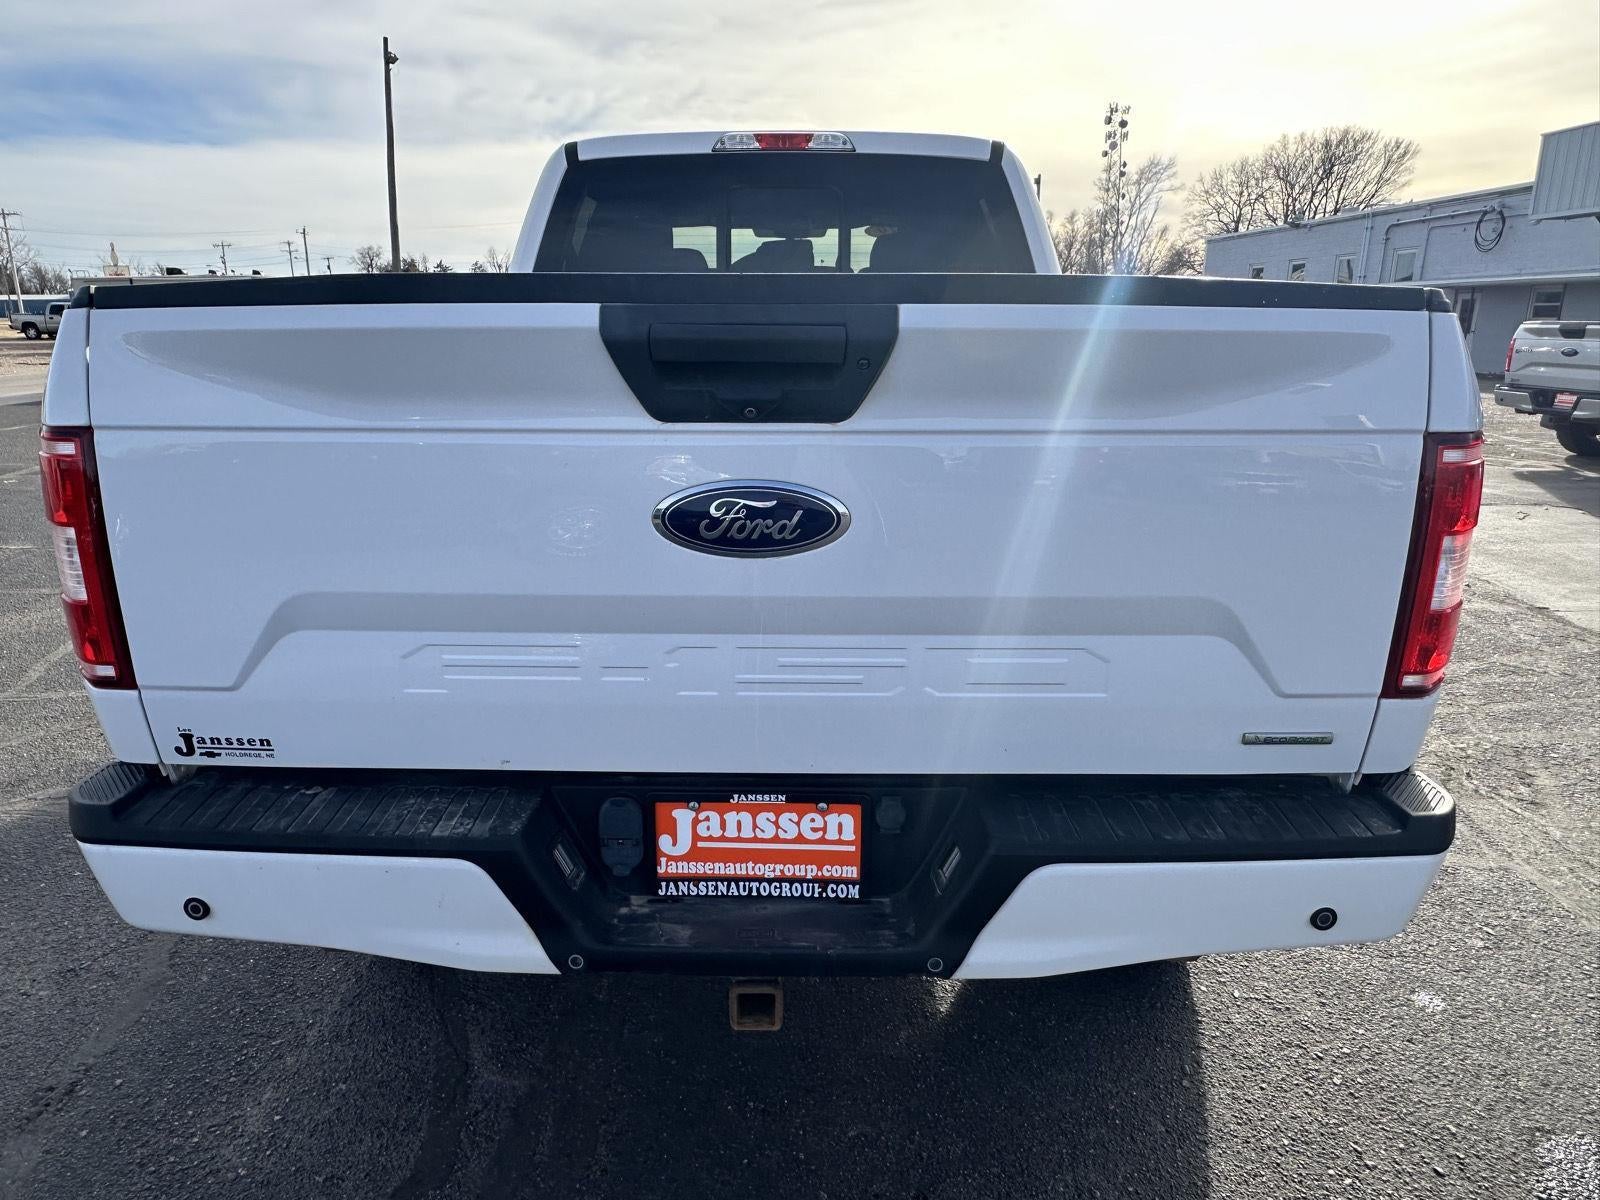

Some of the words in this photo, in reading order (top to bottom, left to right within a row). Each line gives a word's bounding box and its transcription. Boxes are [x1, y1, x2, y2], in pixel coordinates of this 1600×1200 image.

[699, 497, 804, 540] Ford
[173, 732, 273, 757] Janssen
[729, 793, 787, 804] JANSSEN
[658, 808, 856, 857] Janssen
[656, 857, 858, 879] Janssenautogroup.com
